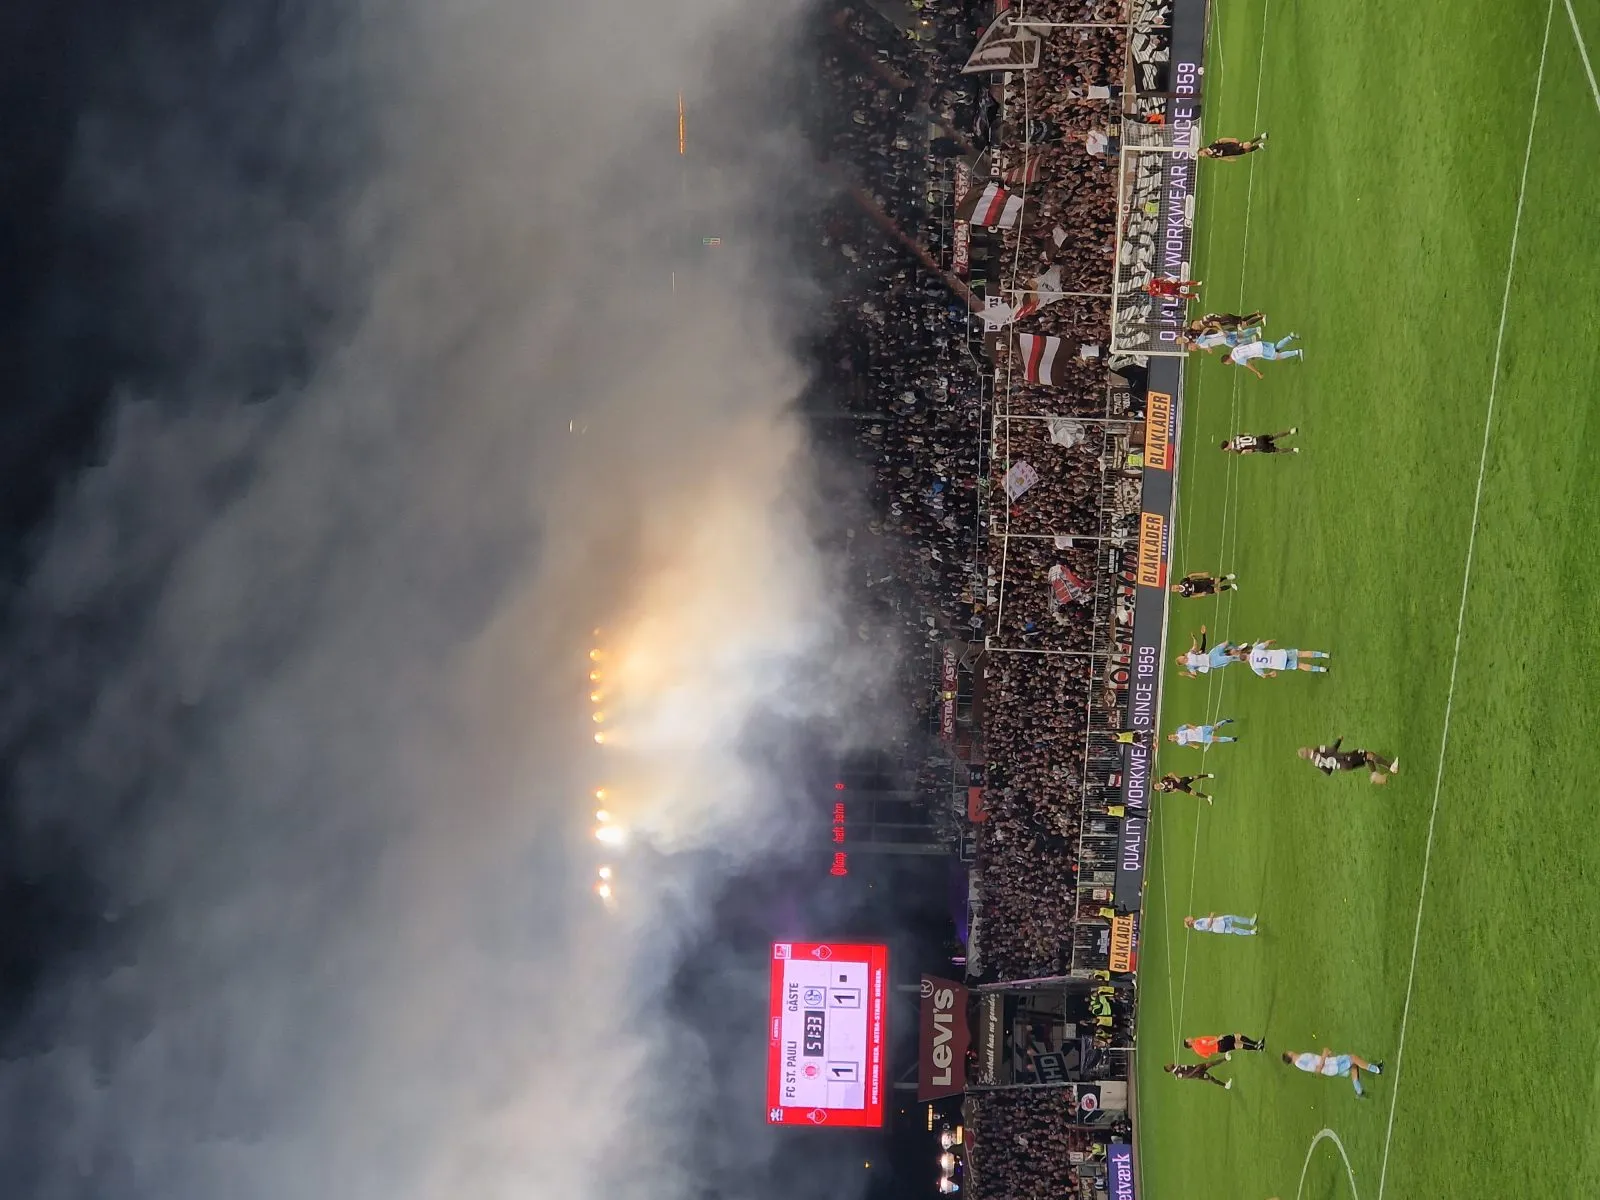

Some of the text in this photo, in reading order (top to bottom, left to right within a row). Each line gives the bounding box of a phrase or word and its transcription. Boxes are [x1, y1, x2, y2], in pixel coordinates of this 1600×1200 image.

[1176, 63, 1195, 103] 1959
[1172, 108, 1192, 160] SINCE
[1164, 166, 1188, 266] WORKWEAR
[1146, 396, 1168, 465] BLÅKLÄDER
[1240, 436, 1253, 448] 10
[1140, 516, 1161, 583] BLÅKLÄDER
[1138, 646, 1155, 679] 1959
[1134, 684, 1152, 724] SINCE
[1123, 818, 1141, 870] QUALITY
[786, 982, 798, 1012] GÄSTE
[834, 995, 855, 1004] 1
[806, 1017, 822, 1050] 51:33
[983, 994, 997, 1084] Football has no gender
[786, 1041, 797, 1098] FC ST. PAULI
[832, 1068, 853, 1077] 1
